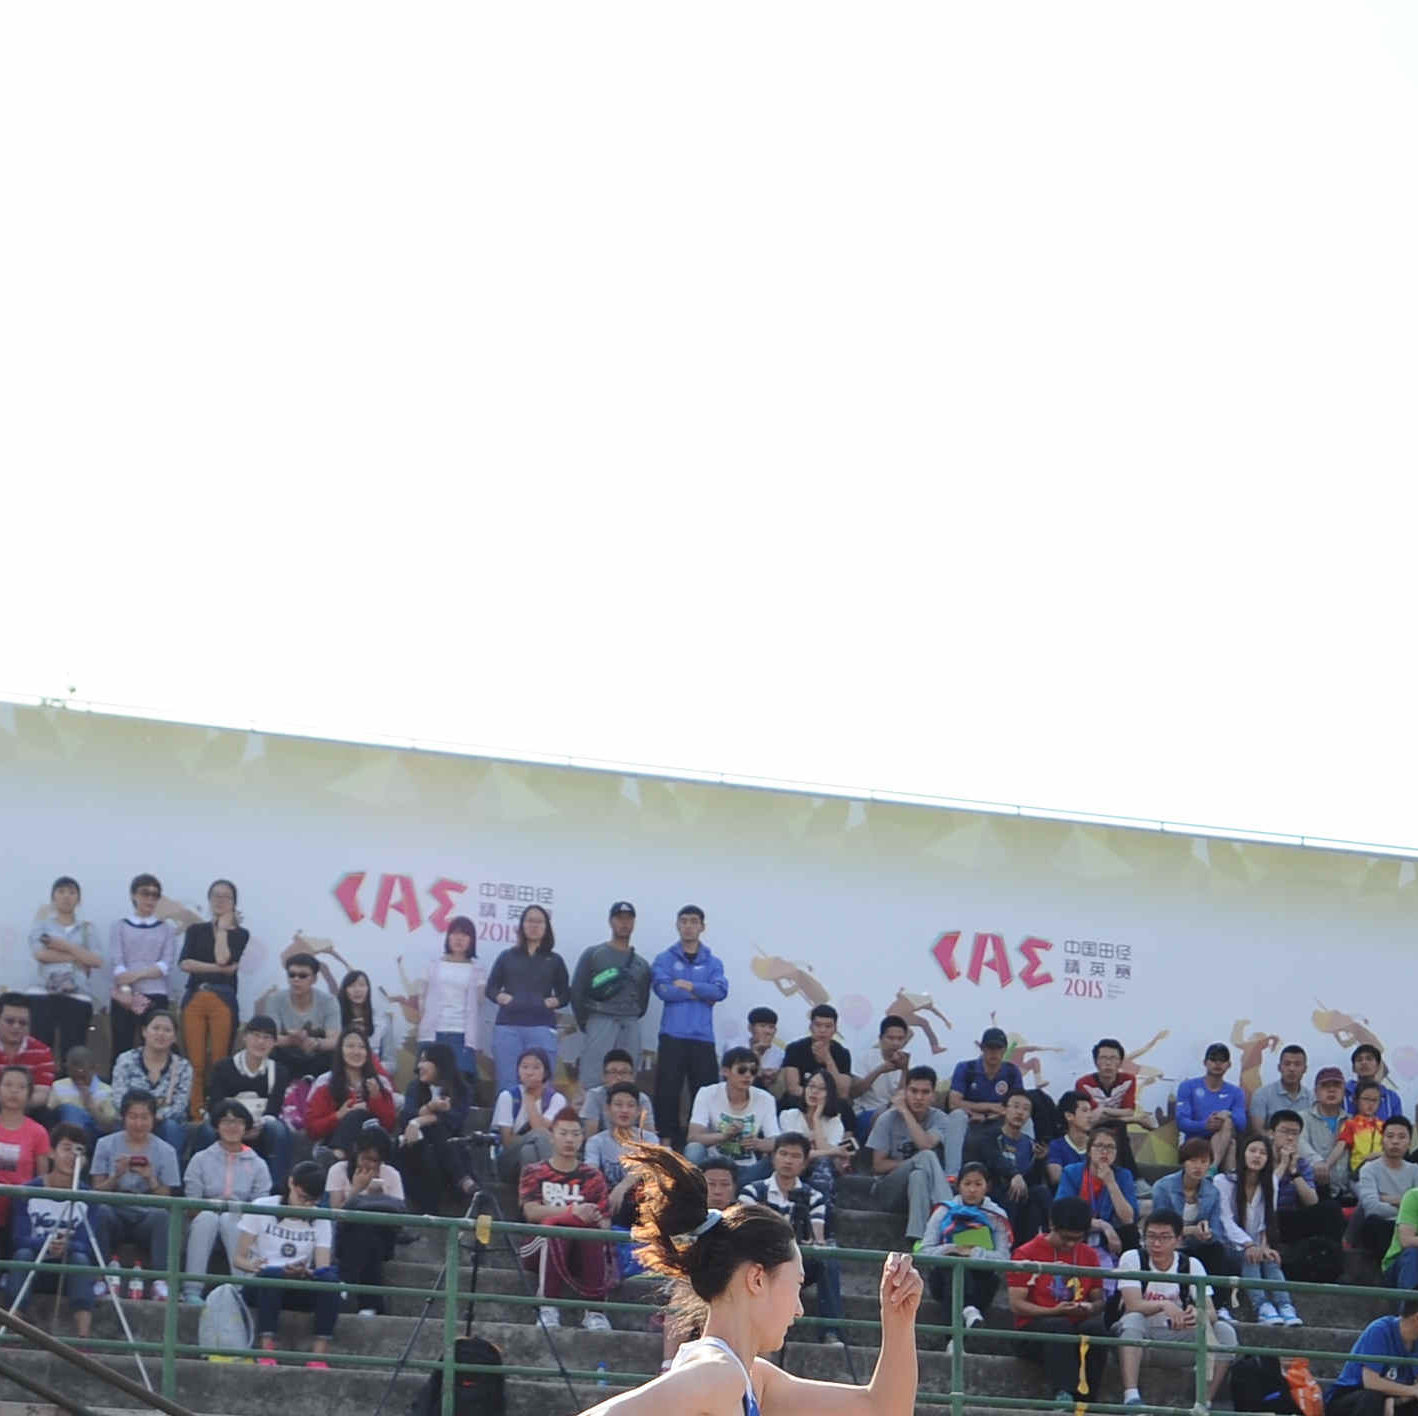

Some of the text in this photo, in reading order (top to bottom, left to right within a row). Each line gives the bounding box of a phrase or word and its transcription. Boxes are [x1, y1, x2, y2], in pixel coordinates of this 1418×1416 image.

[478, 882, 555, 905] 中国田径
[1063, 940, 1131, 961] 中国田径
[1064, 959, 1131, 980] 精英赛
[1064, 977, 1103, 1000] 2015
